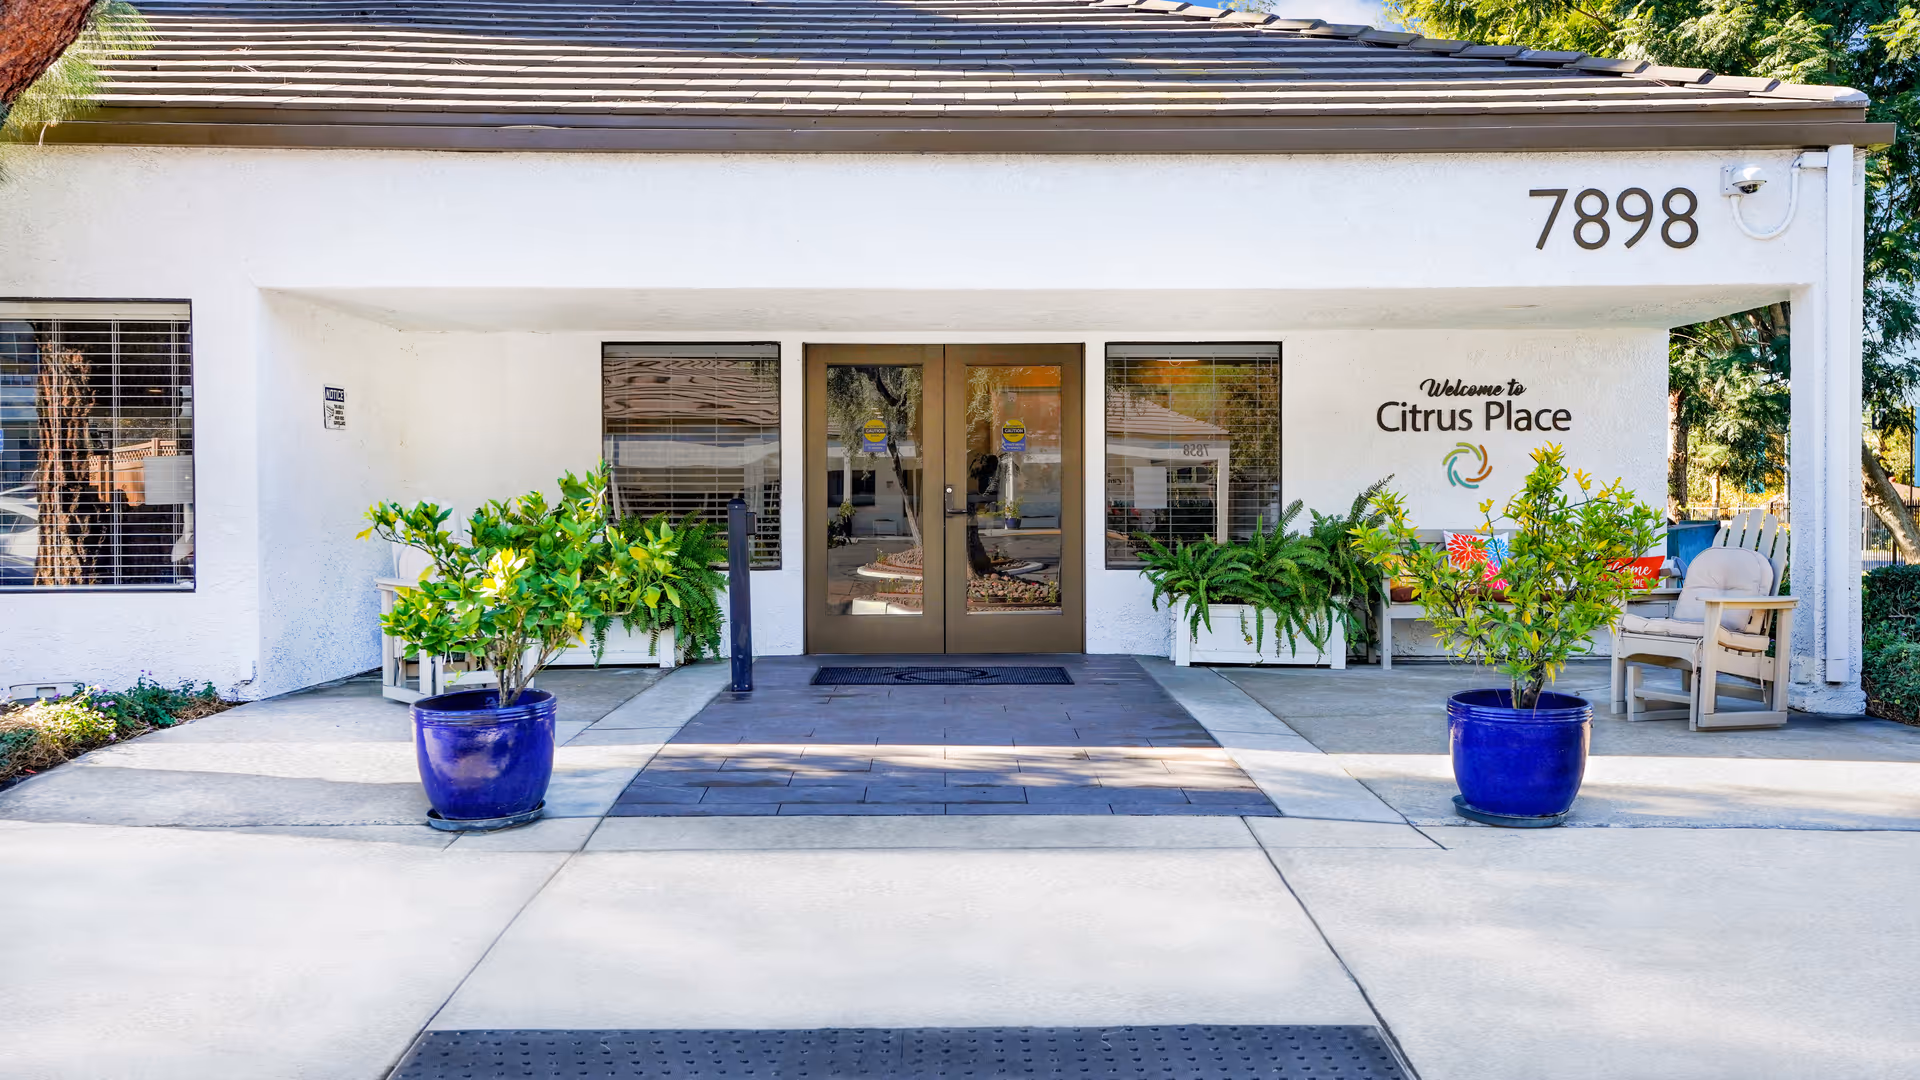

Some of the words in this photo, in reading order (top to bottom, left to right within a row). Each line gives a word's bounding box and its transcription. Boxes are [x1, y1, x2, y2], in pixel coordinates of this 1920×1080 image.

[1529, 187, 1699, 250] 7898
[326, 389, 344, 401] NOTICE
[1419, 378, 1505, 397] Welcome
[1507, 378, 1527, 396] to
[1376, 401, 1473, 432] Citrus
[1485, 400, 1572, 431] Place
[1606, 562, 1652, 576] elcome
